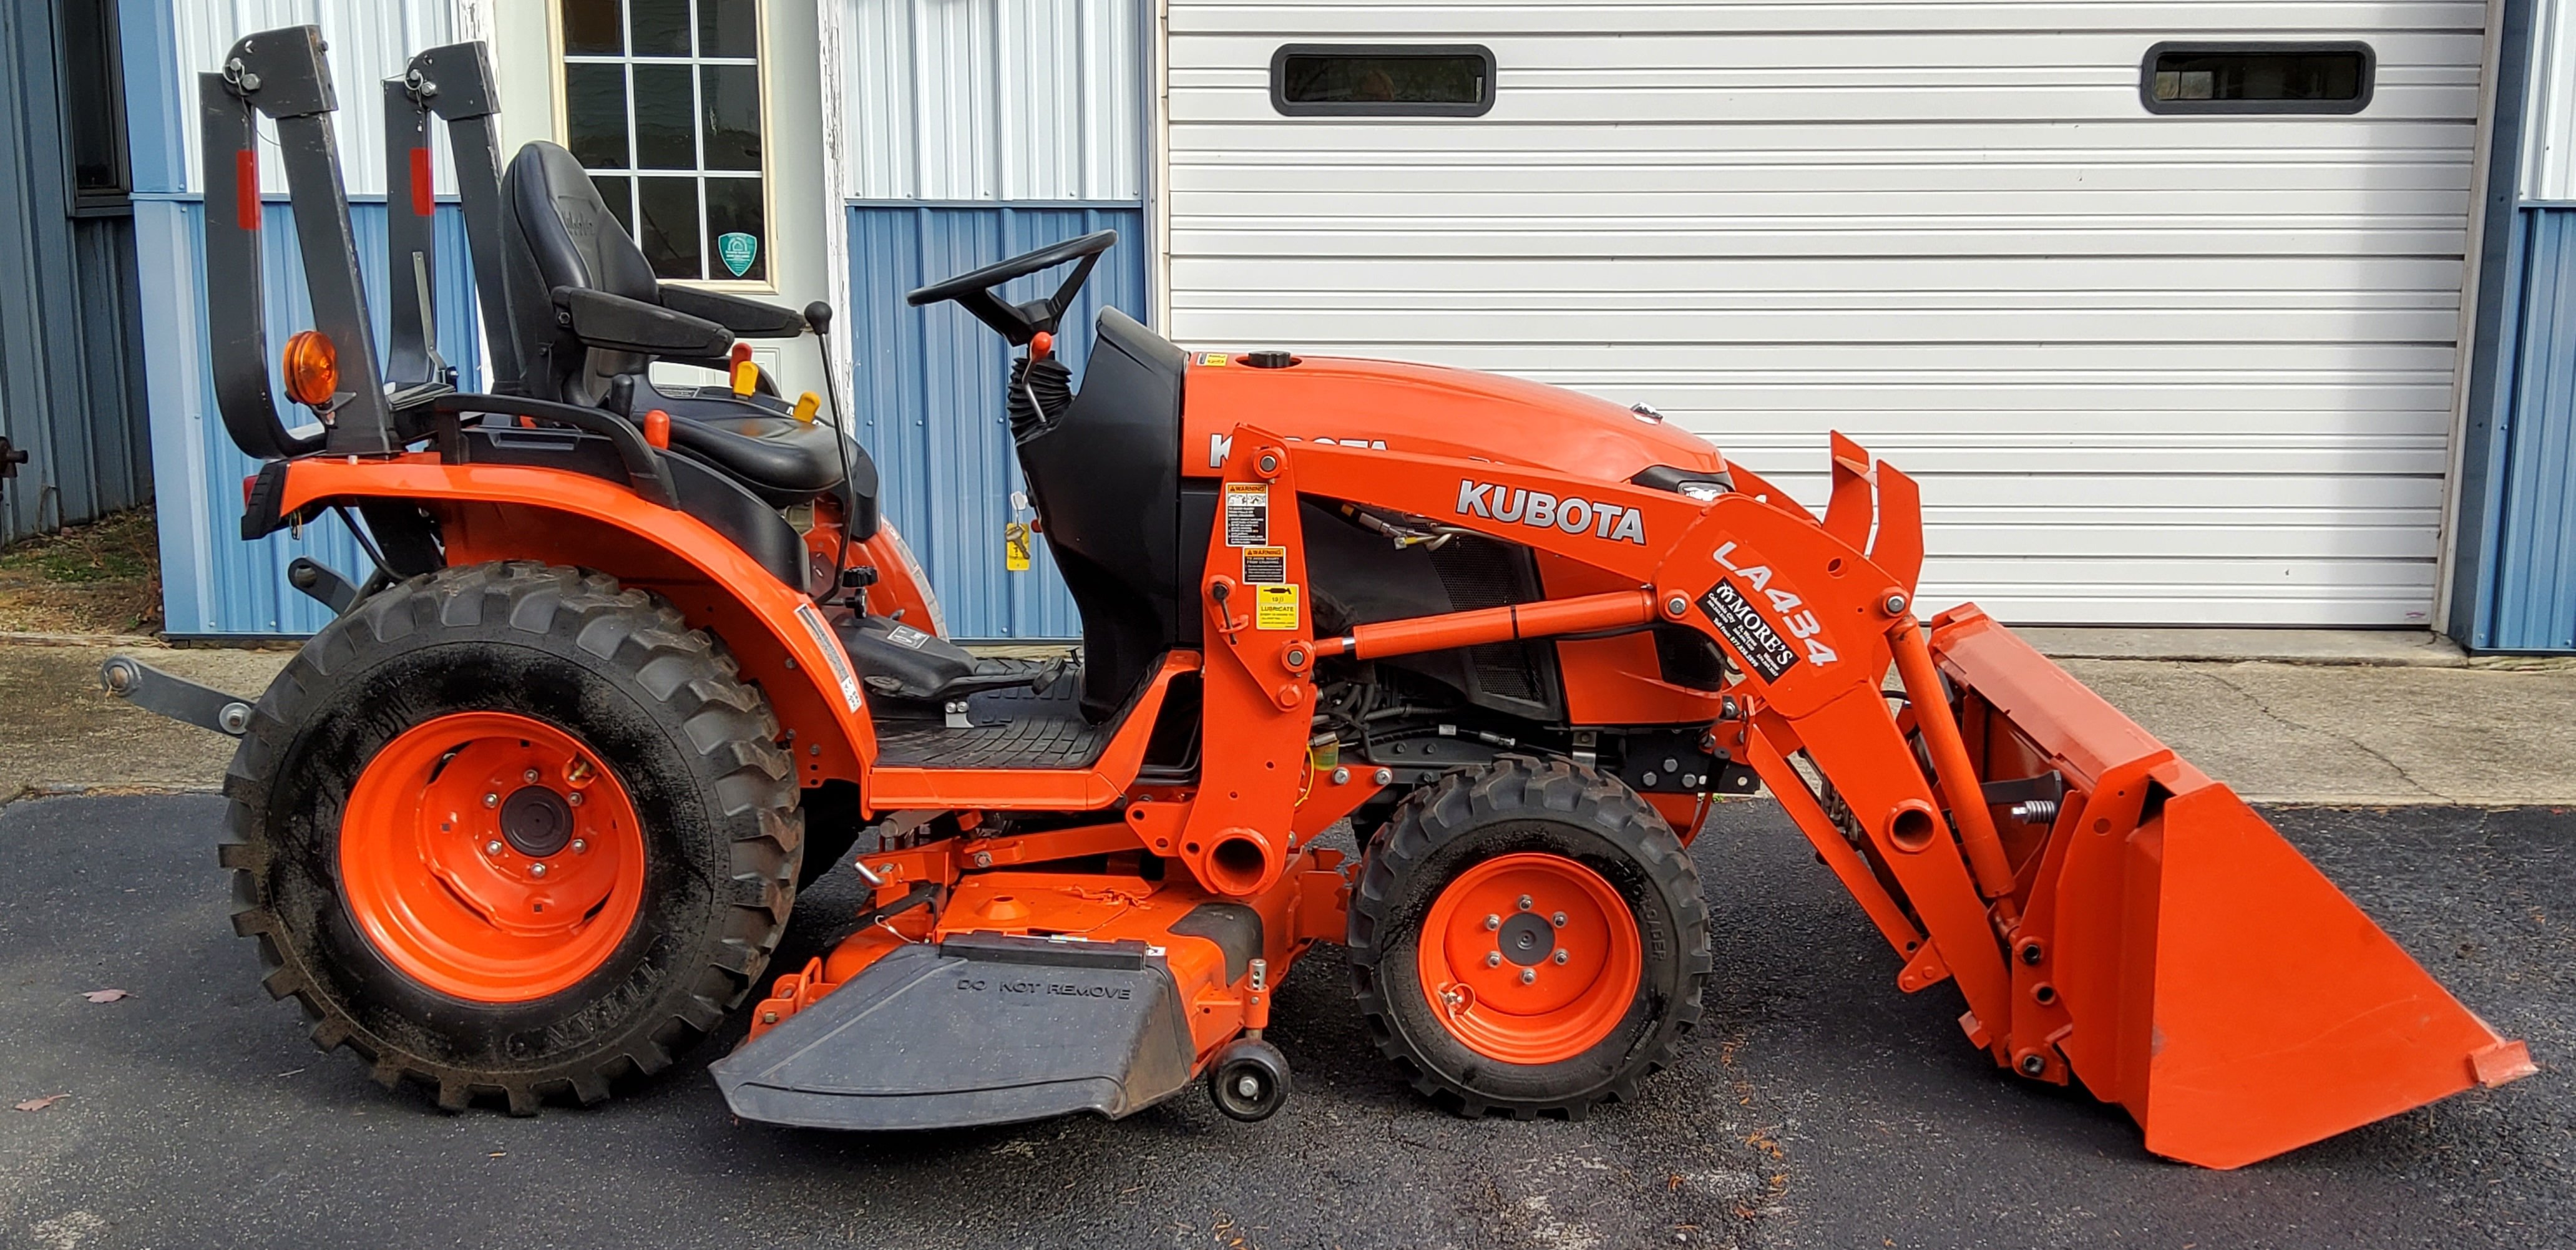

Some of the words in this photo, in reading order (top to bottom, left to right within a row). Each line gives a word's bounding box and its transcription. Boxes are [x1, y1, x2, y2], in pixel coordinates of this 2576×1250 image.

[1456, 479, 1646, 545] KUBOTA
[1712, 540, 1838, 667] LA434
[1728, 597, 1793, 665] MORE'S
[957, 979, 987, 991] DO
[999, 982, 1041, 994] NOT
[1046, 984, 1131, 1000] REMOVE
